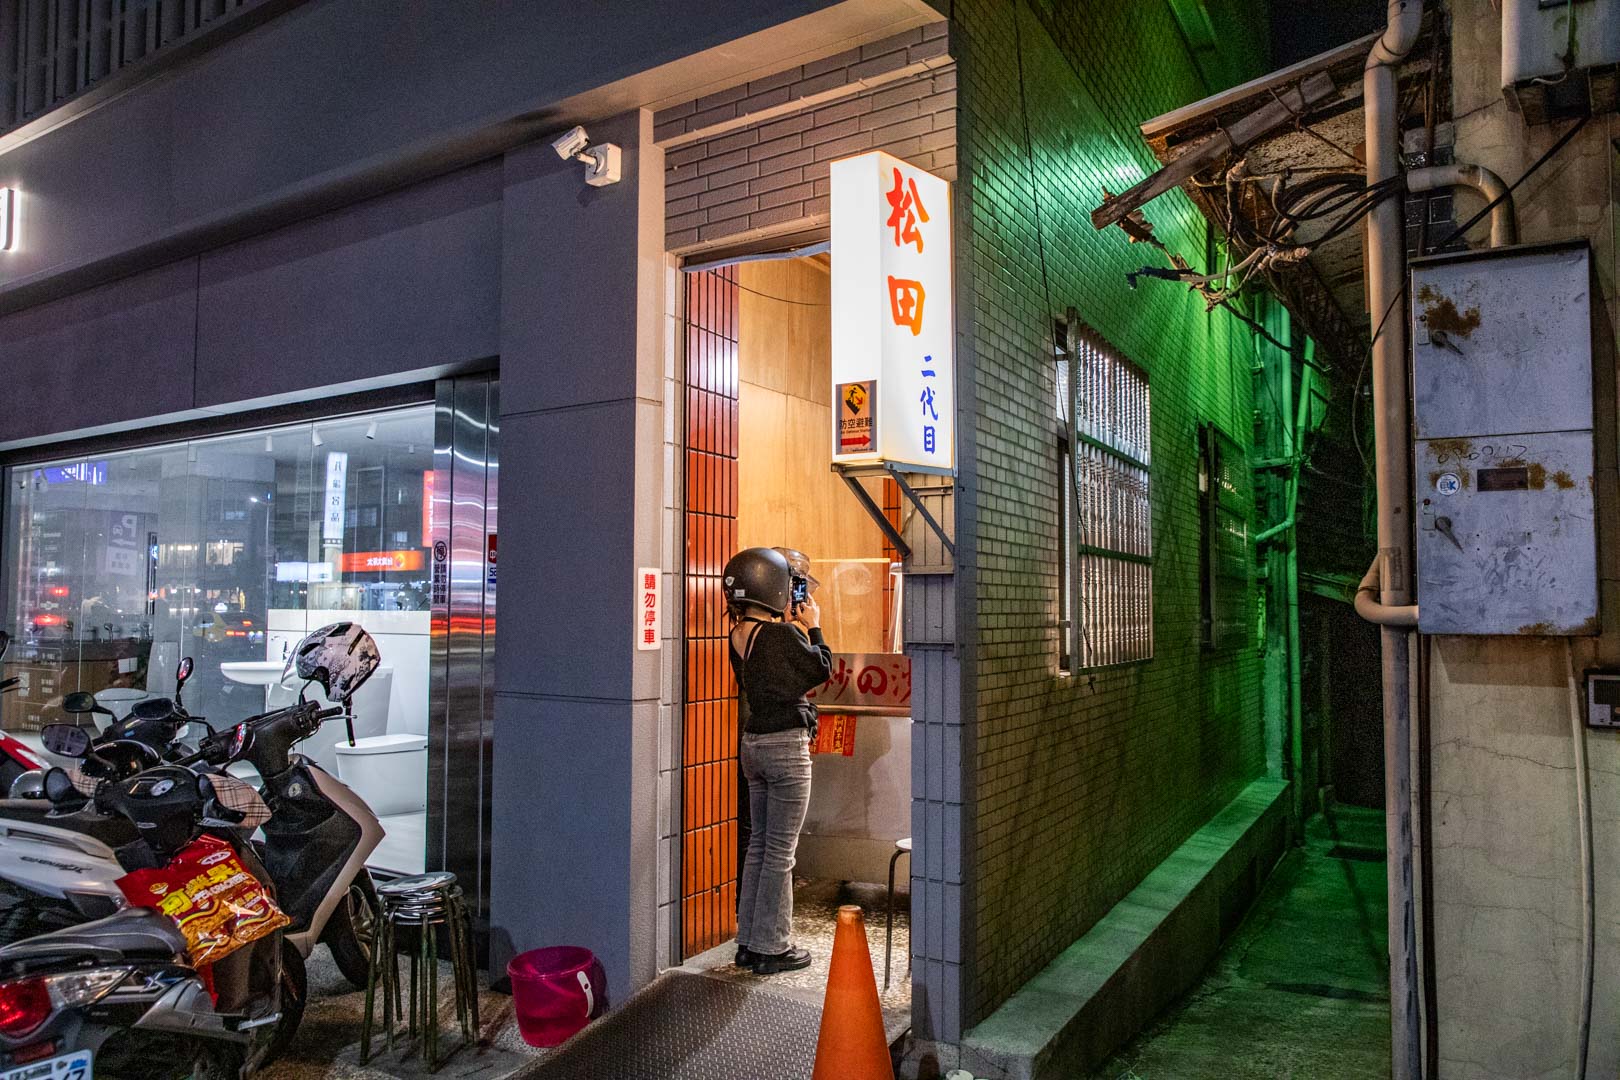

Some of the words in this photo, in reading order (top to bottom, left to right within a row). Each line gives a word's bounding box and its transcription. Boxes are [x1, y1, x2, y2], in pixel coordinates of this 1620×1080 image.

[885, 166, 930, 337] 松田
[839, 417, 873, 429] 防空避難
[920, 354, 938, 454] 二代目
[643, 573, 656, 645] 請勿停車
